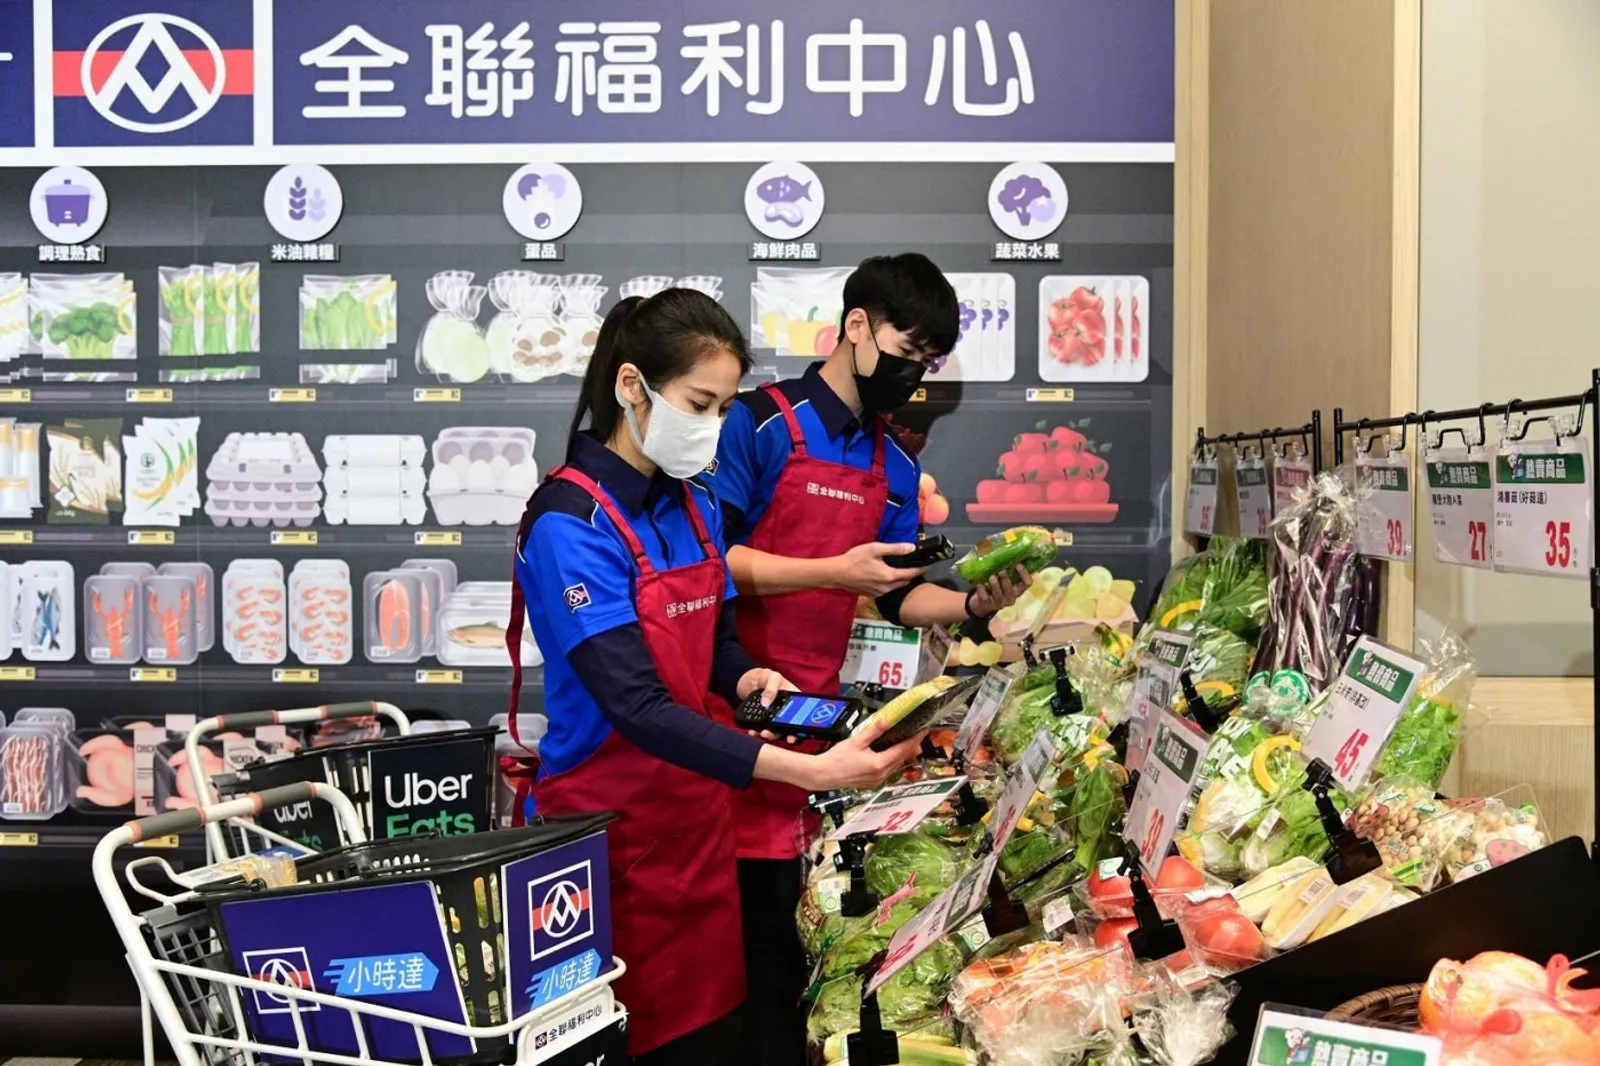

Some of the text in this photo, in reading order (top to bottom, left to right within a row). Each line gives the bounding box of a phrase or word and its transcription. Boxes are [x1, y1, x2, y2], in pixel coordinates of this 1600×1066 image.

[300, 18, 1035, 118] 全聯福利中心
[38, 244, 102, 261] 調理熟食
[525, 242, 557, 259] 蛋品
[752, 242, 818, 259] 海鮮肉品
[995, 242, 1060, 259] 蔬菜水果
[1525, 458, 1567, 480] 熱賣商品
[1386, 518, 1403, 557] 39
[1468, 520, 1487, 562] 27
[1544, 520, 1571, 569] 35
[878, 661, 903, 686] 65
[1334, 728, 1370, 779] 45
[384, 772, 473, 809] Uber
[877, 810, 914, 832] 32
[1140, 808, 1165, 864] 39
[347, 955, 425, 993] 小時達
[541, 951, 595, 1001] 小時達
[548, 1003, 603, 1044] 全聯福利中心
